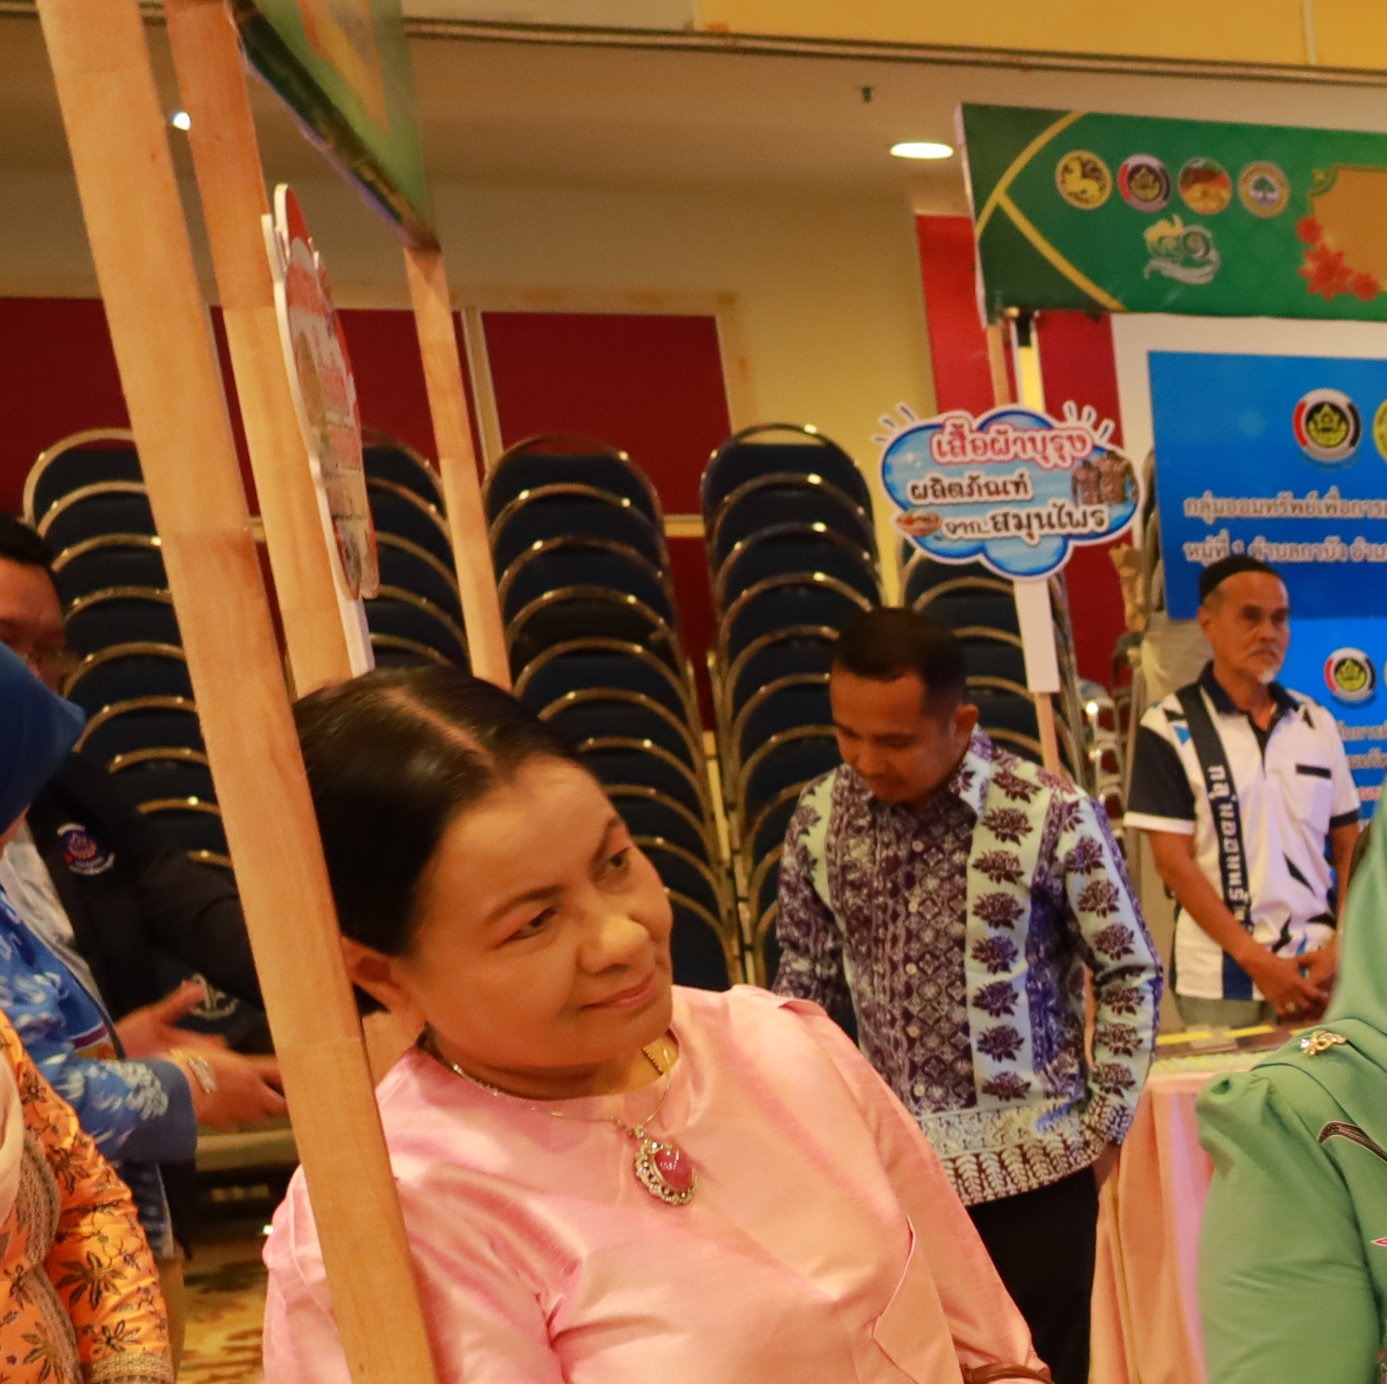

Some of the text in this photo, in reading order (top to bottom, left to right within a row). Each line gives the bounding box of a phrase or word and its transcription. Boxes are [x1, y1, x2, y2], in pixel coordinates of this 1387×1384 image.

[910, 472, 1029, 502] ผลิตภัณฑ์
[989, 503, 1107, 541] สมุนไพร
